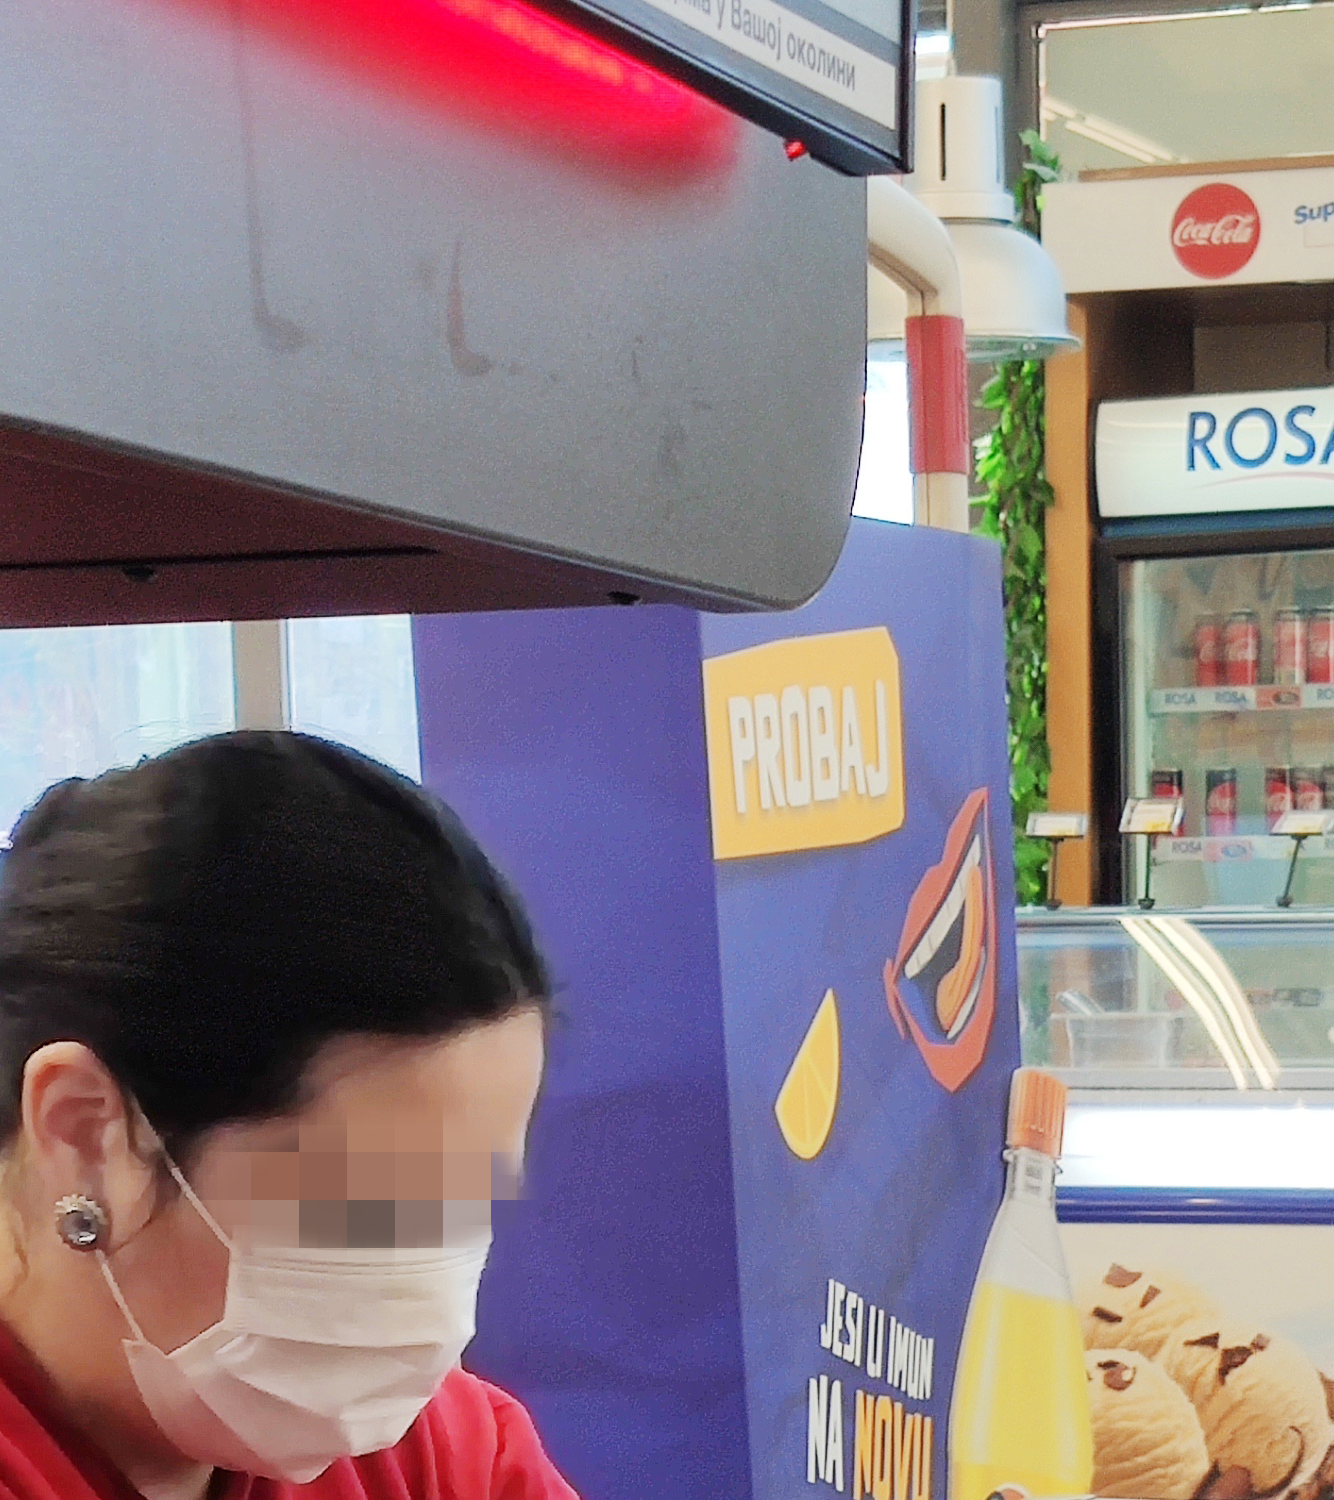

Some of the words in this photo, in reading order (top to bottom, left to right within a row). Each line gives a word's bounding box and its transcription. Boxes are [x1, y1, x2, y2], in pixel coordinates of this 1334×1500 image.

[730, 0, 782, 61] Вашој
[786, 32, 856, 92] околини
[728, 680, 889, 814] PROBAJ
[820, 1278, 864, 1367] JESI
[866, 1304, 885, 1378] LI
[887, 1315, 934, 1400] IMUN
[807, 1373, 844, 1492] NA
